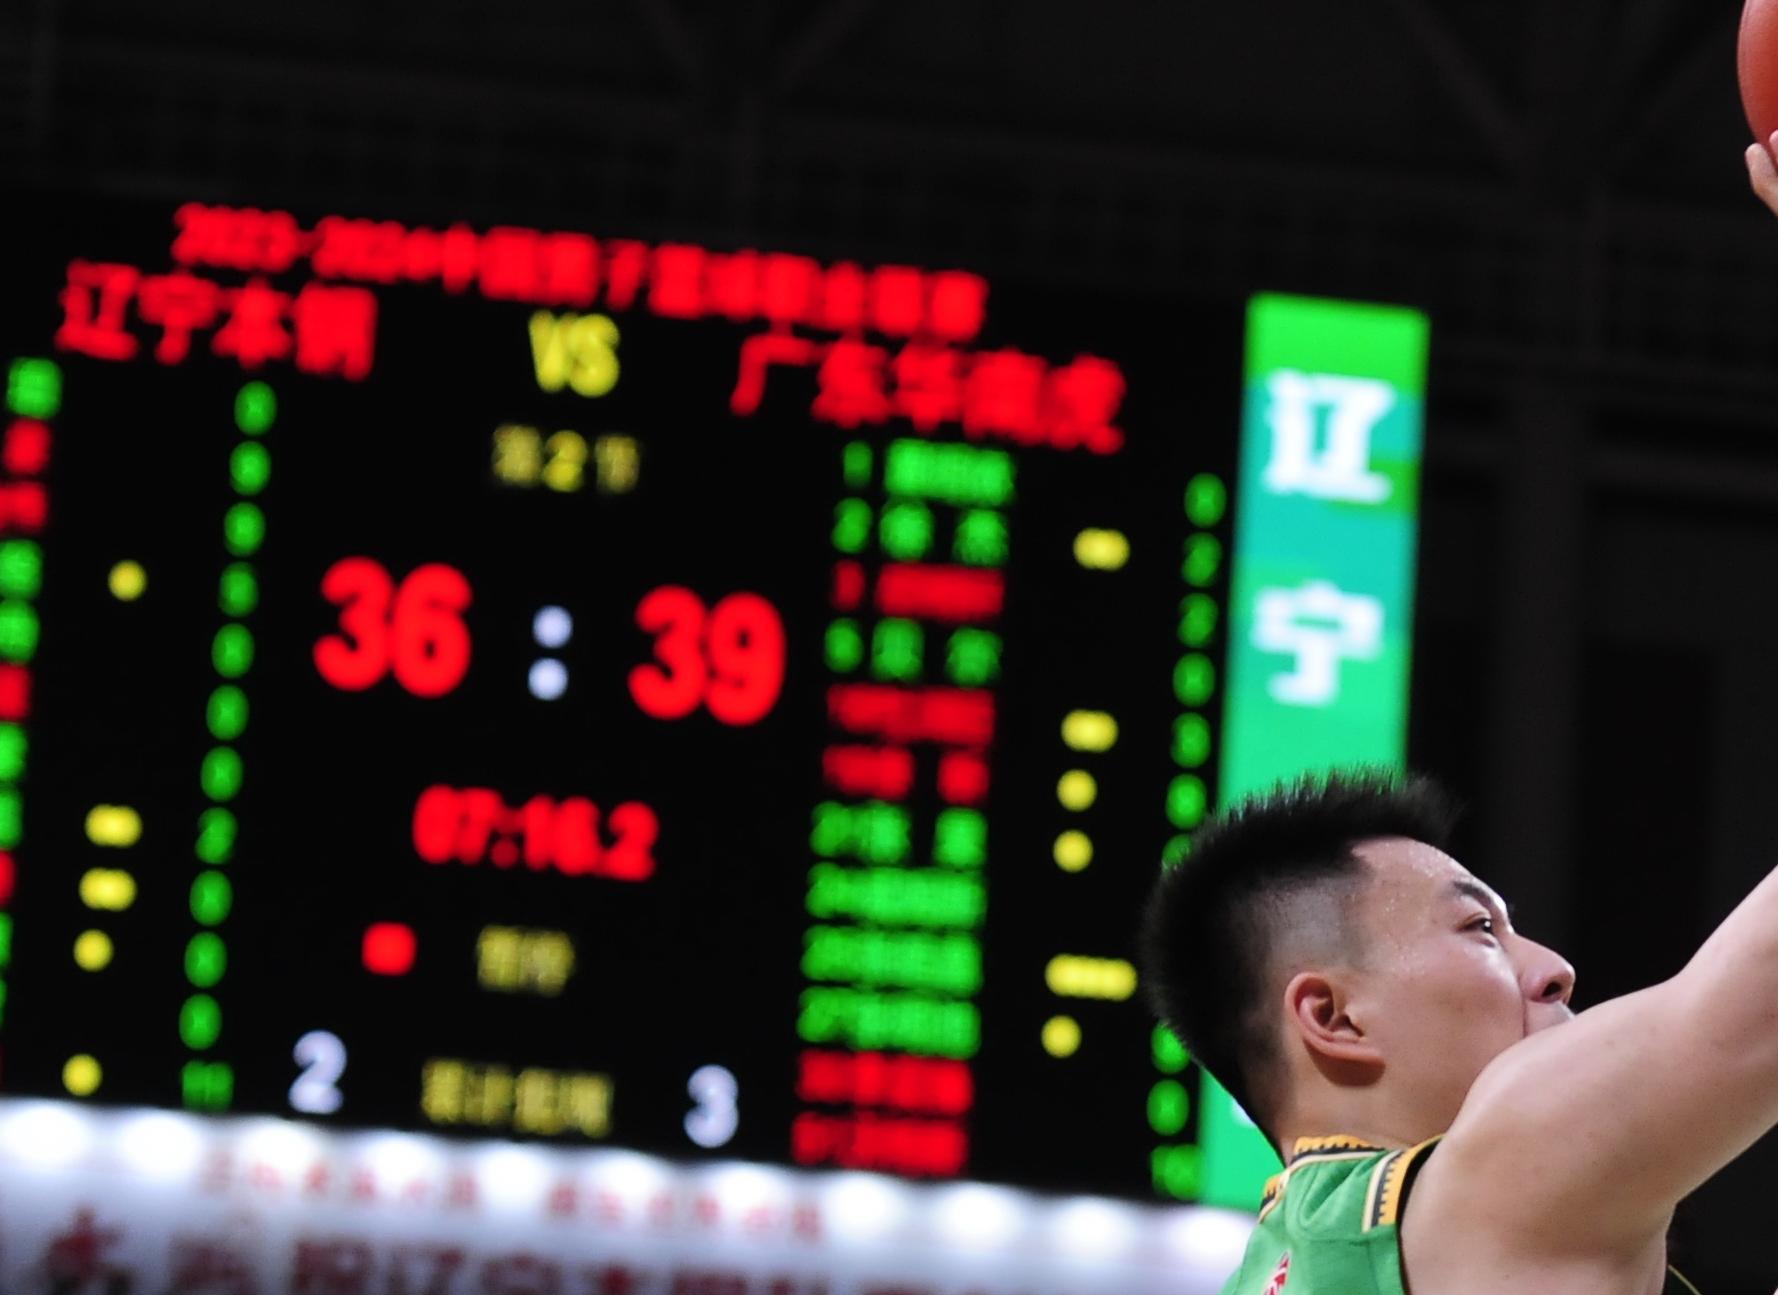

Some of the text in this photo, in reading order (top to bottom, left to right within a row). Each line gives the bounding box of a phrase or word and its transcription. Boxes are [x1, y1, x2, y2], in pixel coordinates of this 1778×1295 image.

[528, 309, 620, 398] VS
[313, 556, 472, 698] 36
[628, 585, 786, 725] 39
[289, 1029, 347, 1114] 2
[683, 1064, 739, 1148] 3
